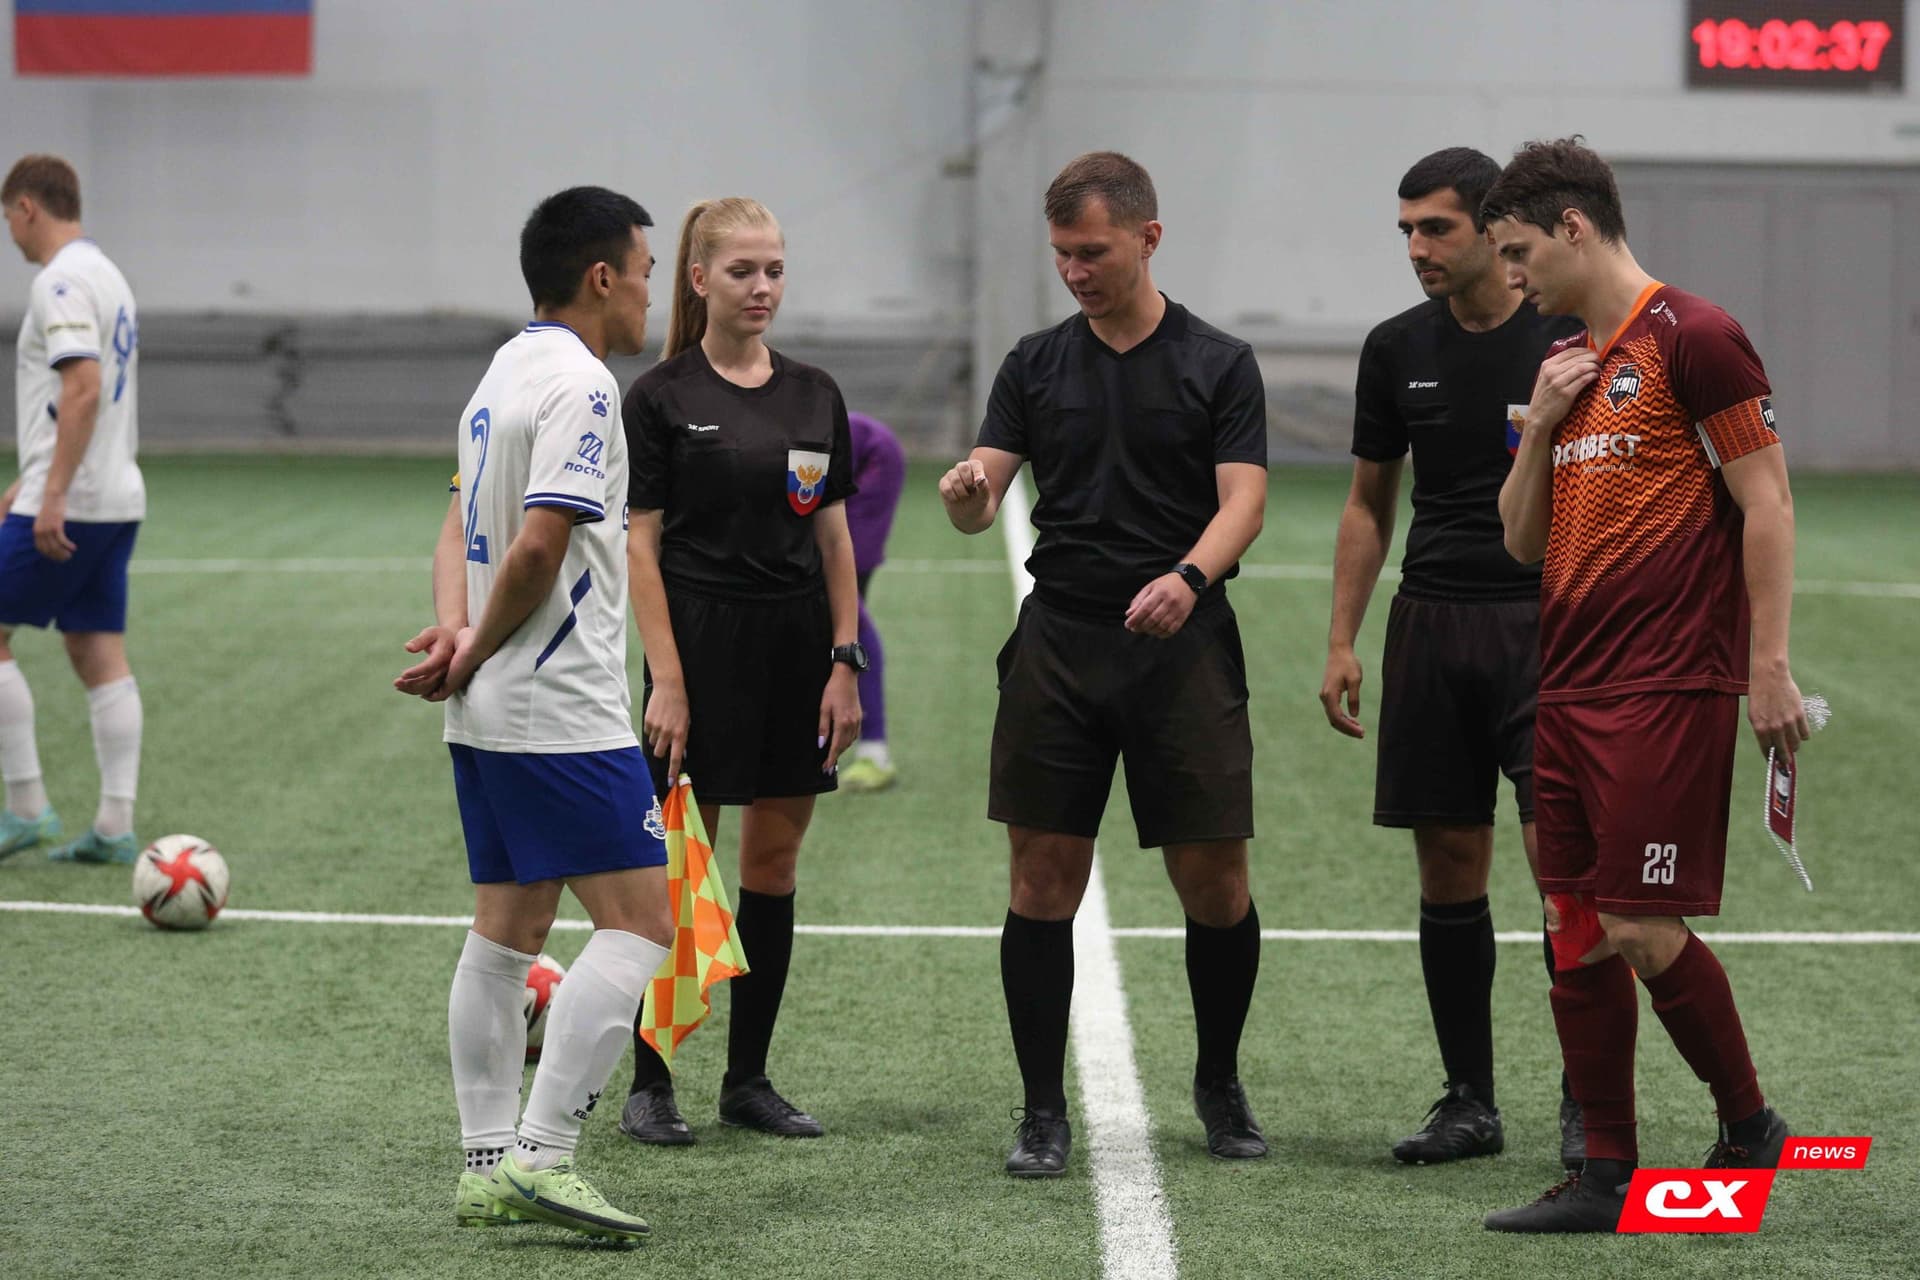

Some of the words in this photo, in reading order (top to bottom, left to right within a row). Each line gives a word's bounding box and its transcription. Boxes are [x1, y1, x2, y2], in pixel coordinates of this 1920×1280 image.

[1692, 18, 1892, 71] 19:02:37
[465, 407, 491, 564] 2
[1642, 843, 1678, 885] 23
